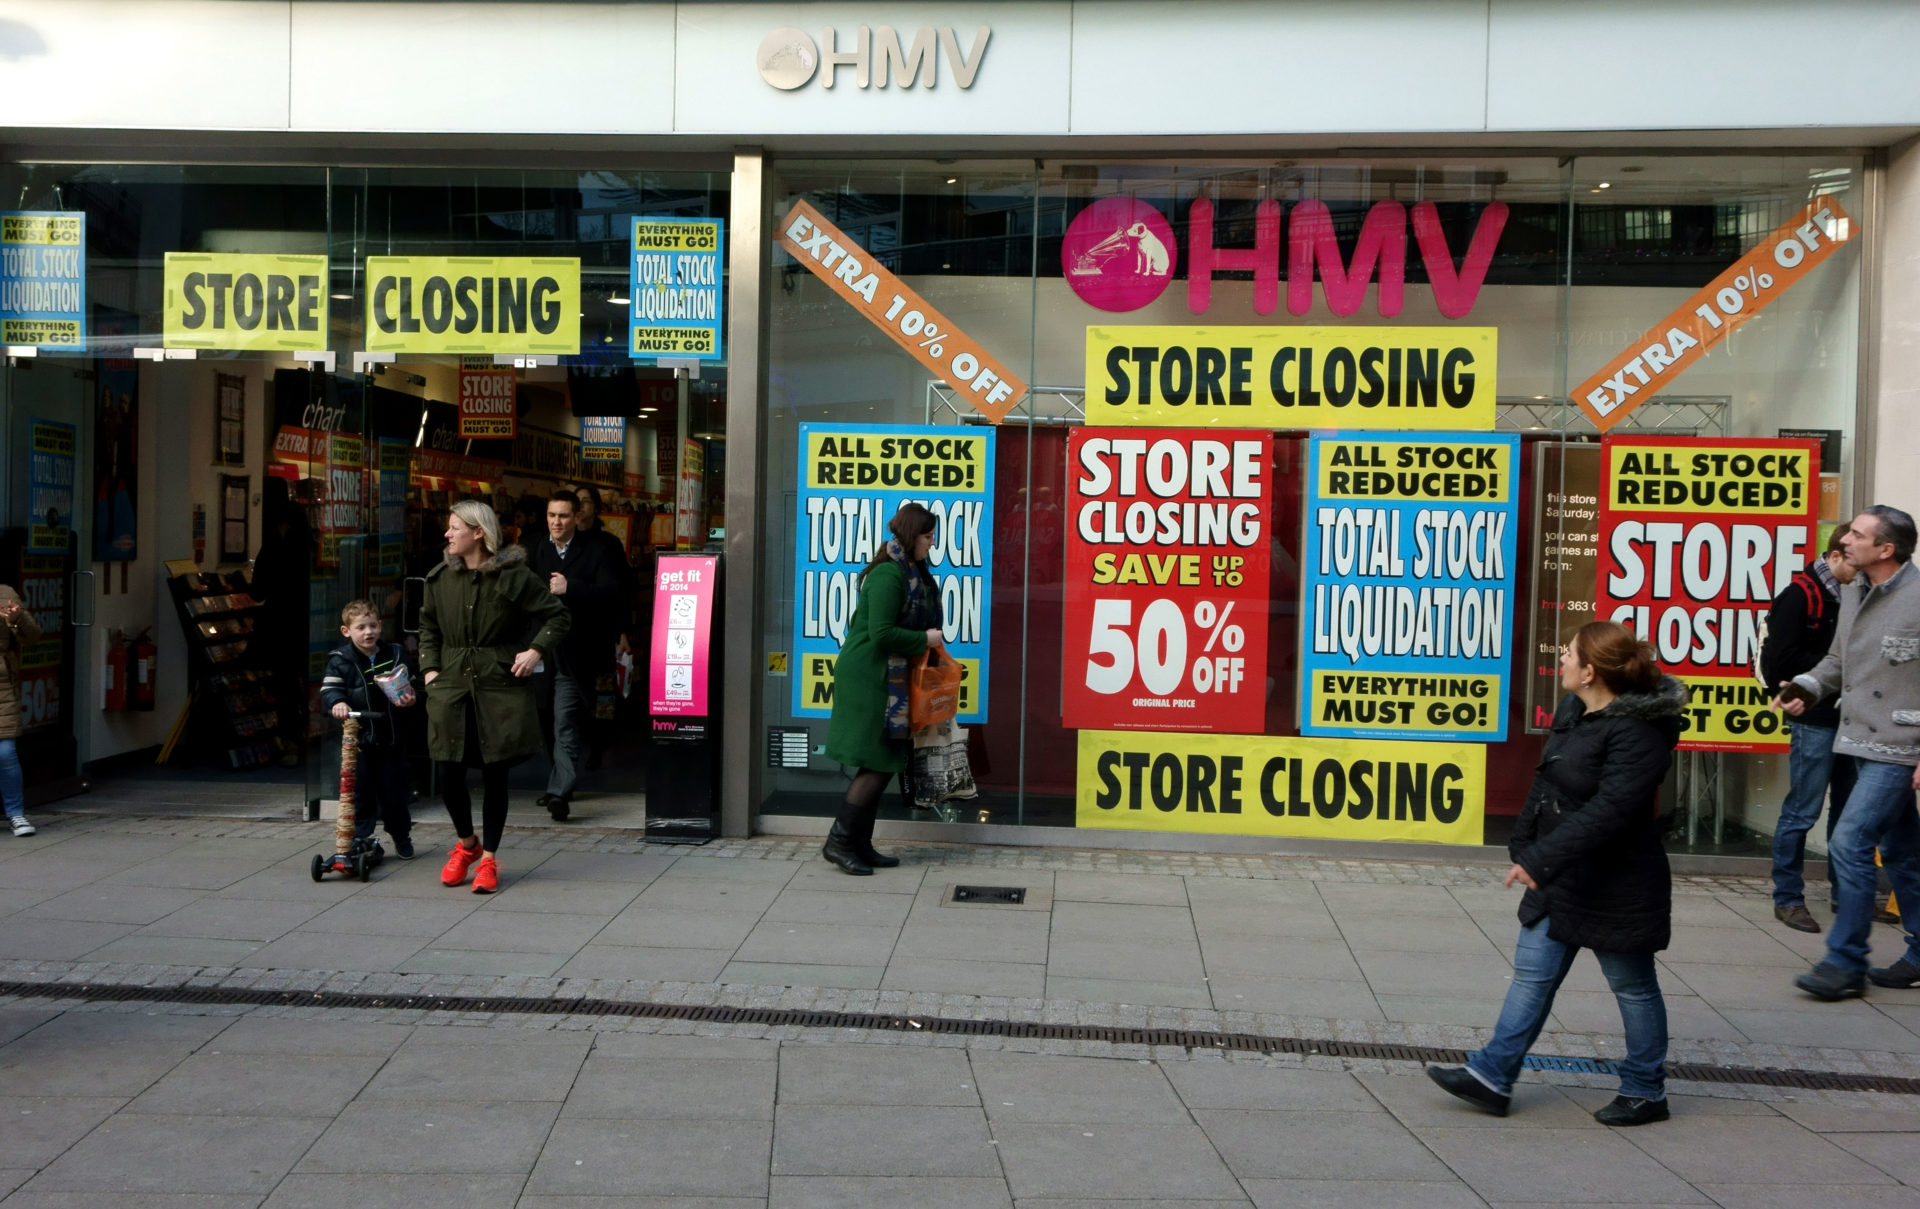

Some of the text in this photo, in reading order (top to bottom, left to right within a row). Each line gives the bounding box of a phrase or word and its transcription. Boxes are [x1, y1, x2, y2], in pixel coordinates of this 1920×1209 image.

[821, 24, 991, 89] HMV
[4, 219, 77, 229] EVERYTHING
[4, 229, 77, 241] MUST GO!
[638, 225, 714, 235] EVERYTHING
[639, 236, 714, 248] MUST GO!
[2, 247, 80, 278] TOTAL STOCK
[636, 254, 716, 286] TOTAL STOCK
[1187, 197, 1510, 320] HMV
[2, 281, 80, 314] LIQUIDATION
[182, 271, 561, 334] STORE CLOSING
[635, 287, 716, 324] LIQUIDATION
[784, 214, 880, 304] EXTRA
[884, 294, 949, 359] 10%
[951, 352, 1015, 405] OFF
[5, 321, 75, 331] EVERYTHING
[5, 332, 76, 343] MUST GO!
[638, 329, 710, 339] EVERYTHING
[638, 339, 710, 351] MUST GO!
[1585, 327, 1699, 418] EXTRA
[1695, 266, 1774, 330] 10%
[462, 375, 512, 397] STORE
[1105, 345, 1476, 409] STORE CLOSING
[302, 397, 346, 432] chart
[462, 398, 512, 413] CLOSING
[432, 421, 458, 451] char
[493, 426, 512, 434] GO!
[584, 427, 622, 444] LIQUIDATION
[276, 432, 326, 457] EXTRA 10
[818, 437, 974, 460] ALL STOCK
[1330, 446, 1497, 469] ALL STOCK
[817, 461, 976, 488] REDUCED!
[1079, 438, 1263, 497] STORE
[1619, 452, 1802, 479] ALL STOCK
[332, 469, 361, 502] STORE
[1329, 471, 1498, 498] REDUCED!
[1617, 480, 1801, 508] REDUCED!
[1547, 493, 1596, 504] this store
[333, 503, 360, 529] CLOSING
[1078, 501, 1261, 545] CLOSING
[1546, 507, 1594, 520] Saturday
[897, 498, 984, 567] OCK
[1317, 507, 1507, 580] TOTAL STOCK
[1545, 532, 1565, 542] you
[1567, 533, 1587, 542] can
[661, 570, 701, 584] get fit
[1092, 552, 1244, 585] SAVE UP
[1212, 571, 1244, 586] TO
[22, 577, 63, 609] STORE
[670, 583, 688, 591] 2014
[1567, 601, 1588, 611] 363
[1314, 583, 1504, 665] LIQUIDATION
[1192, 656, 1244, 694] OFF
[1322, 675, 1489, 698] EVERYTHING
[1132, 698, 1196, 708] ORIGINAL PRICE
[1322, 698, 1487, 727] MUST GO!
[653, 719, 677, 731] hmv
[1680, 707, 1791, 736] ST GO!
[1096, 750, 1464, 824] STORE CLOSING
